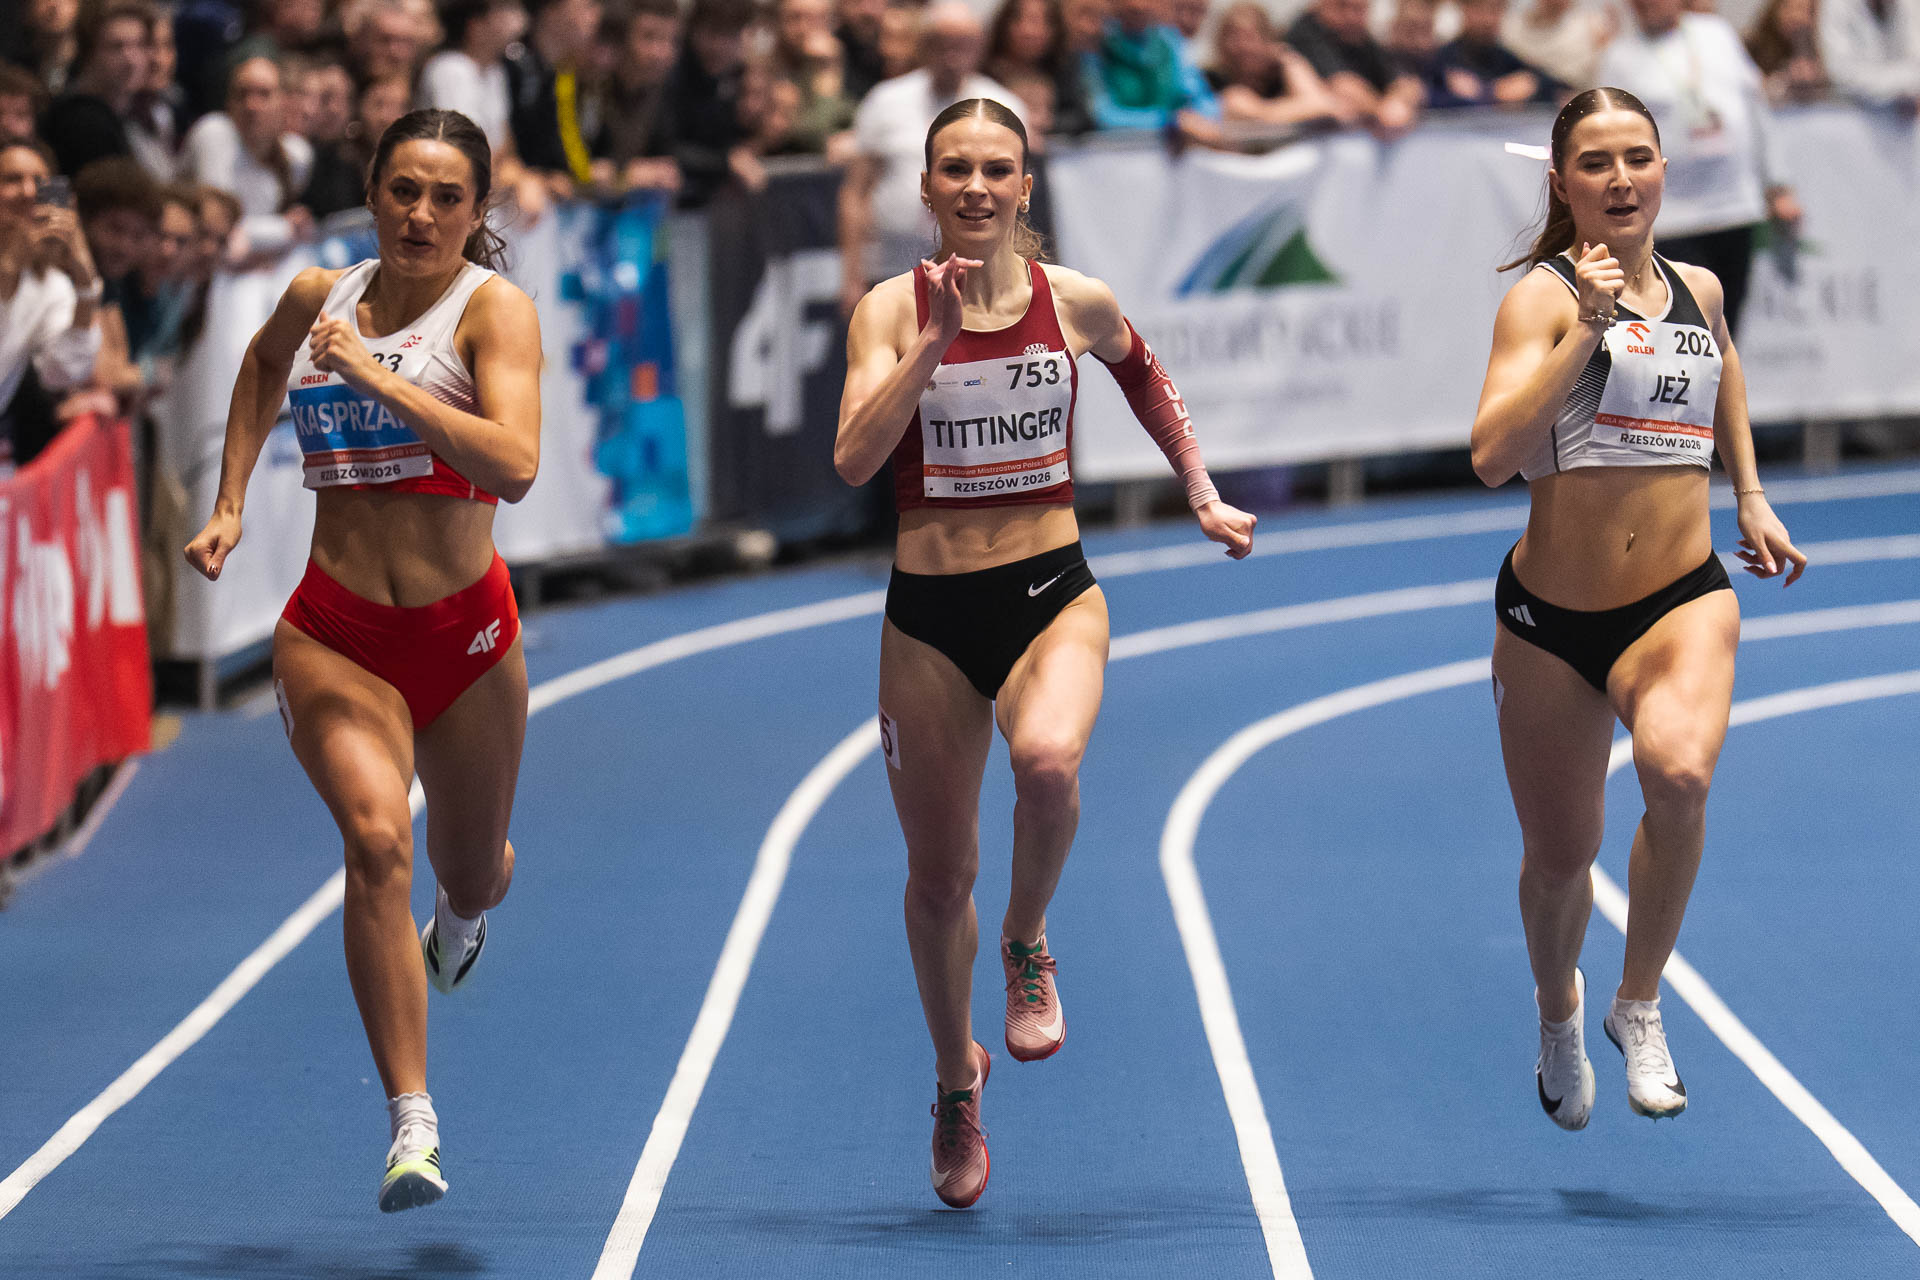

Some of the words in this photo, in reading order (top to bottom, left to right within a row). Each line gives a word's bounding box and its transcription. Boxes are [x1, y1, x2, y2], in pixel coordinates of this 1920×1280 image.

[1626, 345, 1655, 355] ORLEN
[1674, 330, 1714, 357] 202
[300, 374, 329, 386] ORLEN
[1006, 360, 1060, 390] 753
[1649, 369, 1691, 405] JEŻ
[292, 400, 407, 437] KASPRZA
[929, 407, 1062, 448] TITTINGER
[1620, 433, 1677, 447] RZESZÓW
[1679, 438, 1701, 450] 2026
[320, 465, 371, 481] RZESZÓW
[370, 464, 401, 478] 2026
[954, 476, 1019, 492] RZESZÓW
[1022, 471, 1051, 486] 2026
[977, 464, 1021, 475] Mistrzostwa
[467, 618, 501, 655] 4F
